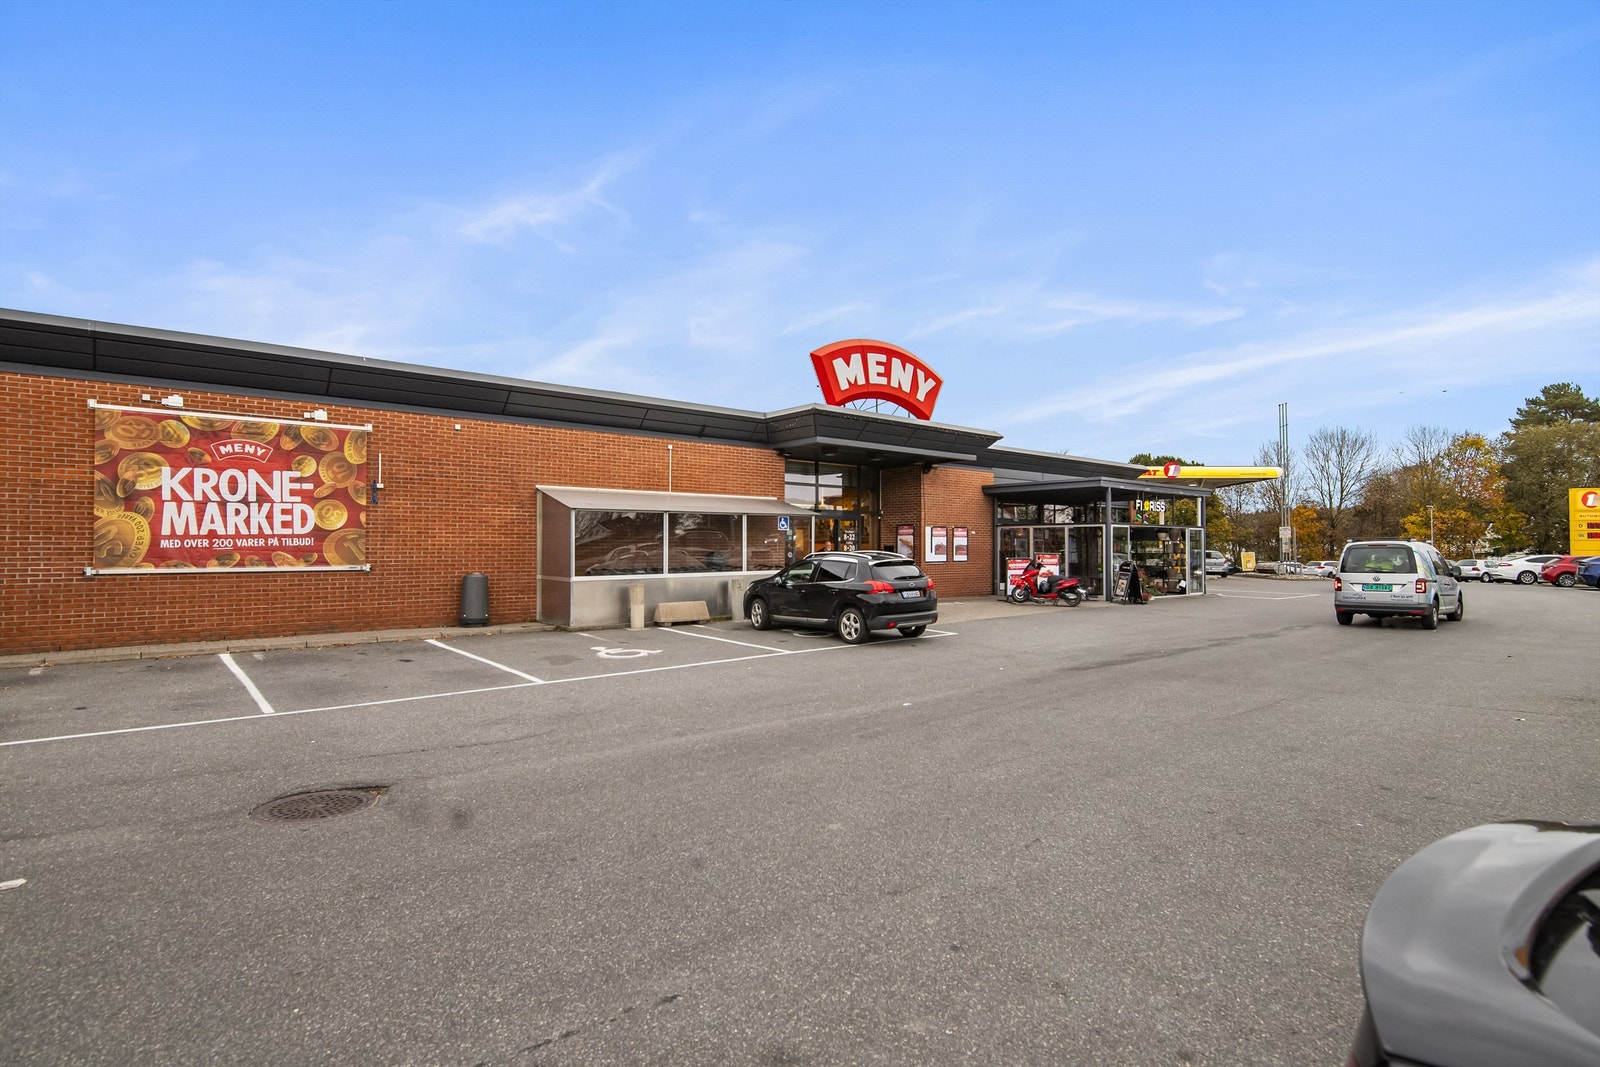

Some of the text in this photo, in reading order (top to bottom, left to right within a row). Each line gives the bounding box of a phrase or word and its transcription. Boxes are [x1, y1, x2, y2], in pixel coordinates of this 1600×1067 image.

[832, 353, 936, 402] MENY
[218, 443, 267, 457] MENY
[161, 466, 315, 504] KRONE-
[160, 501, 316, 537] MARKED
[160, 536, 315, 549] MED OVER 200 VARER PÅ TILBUD!
